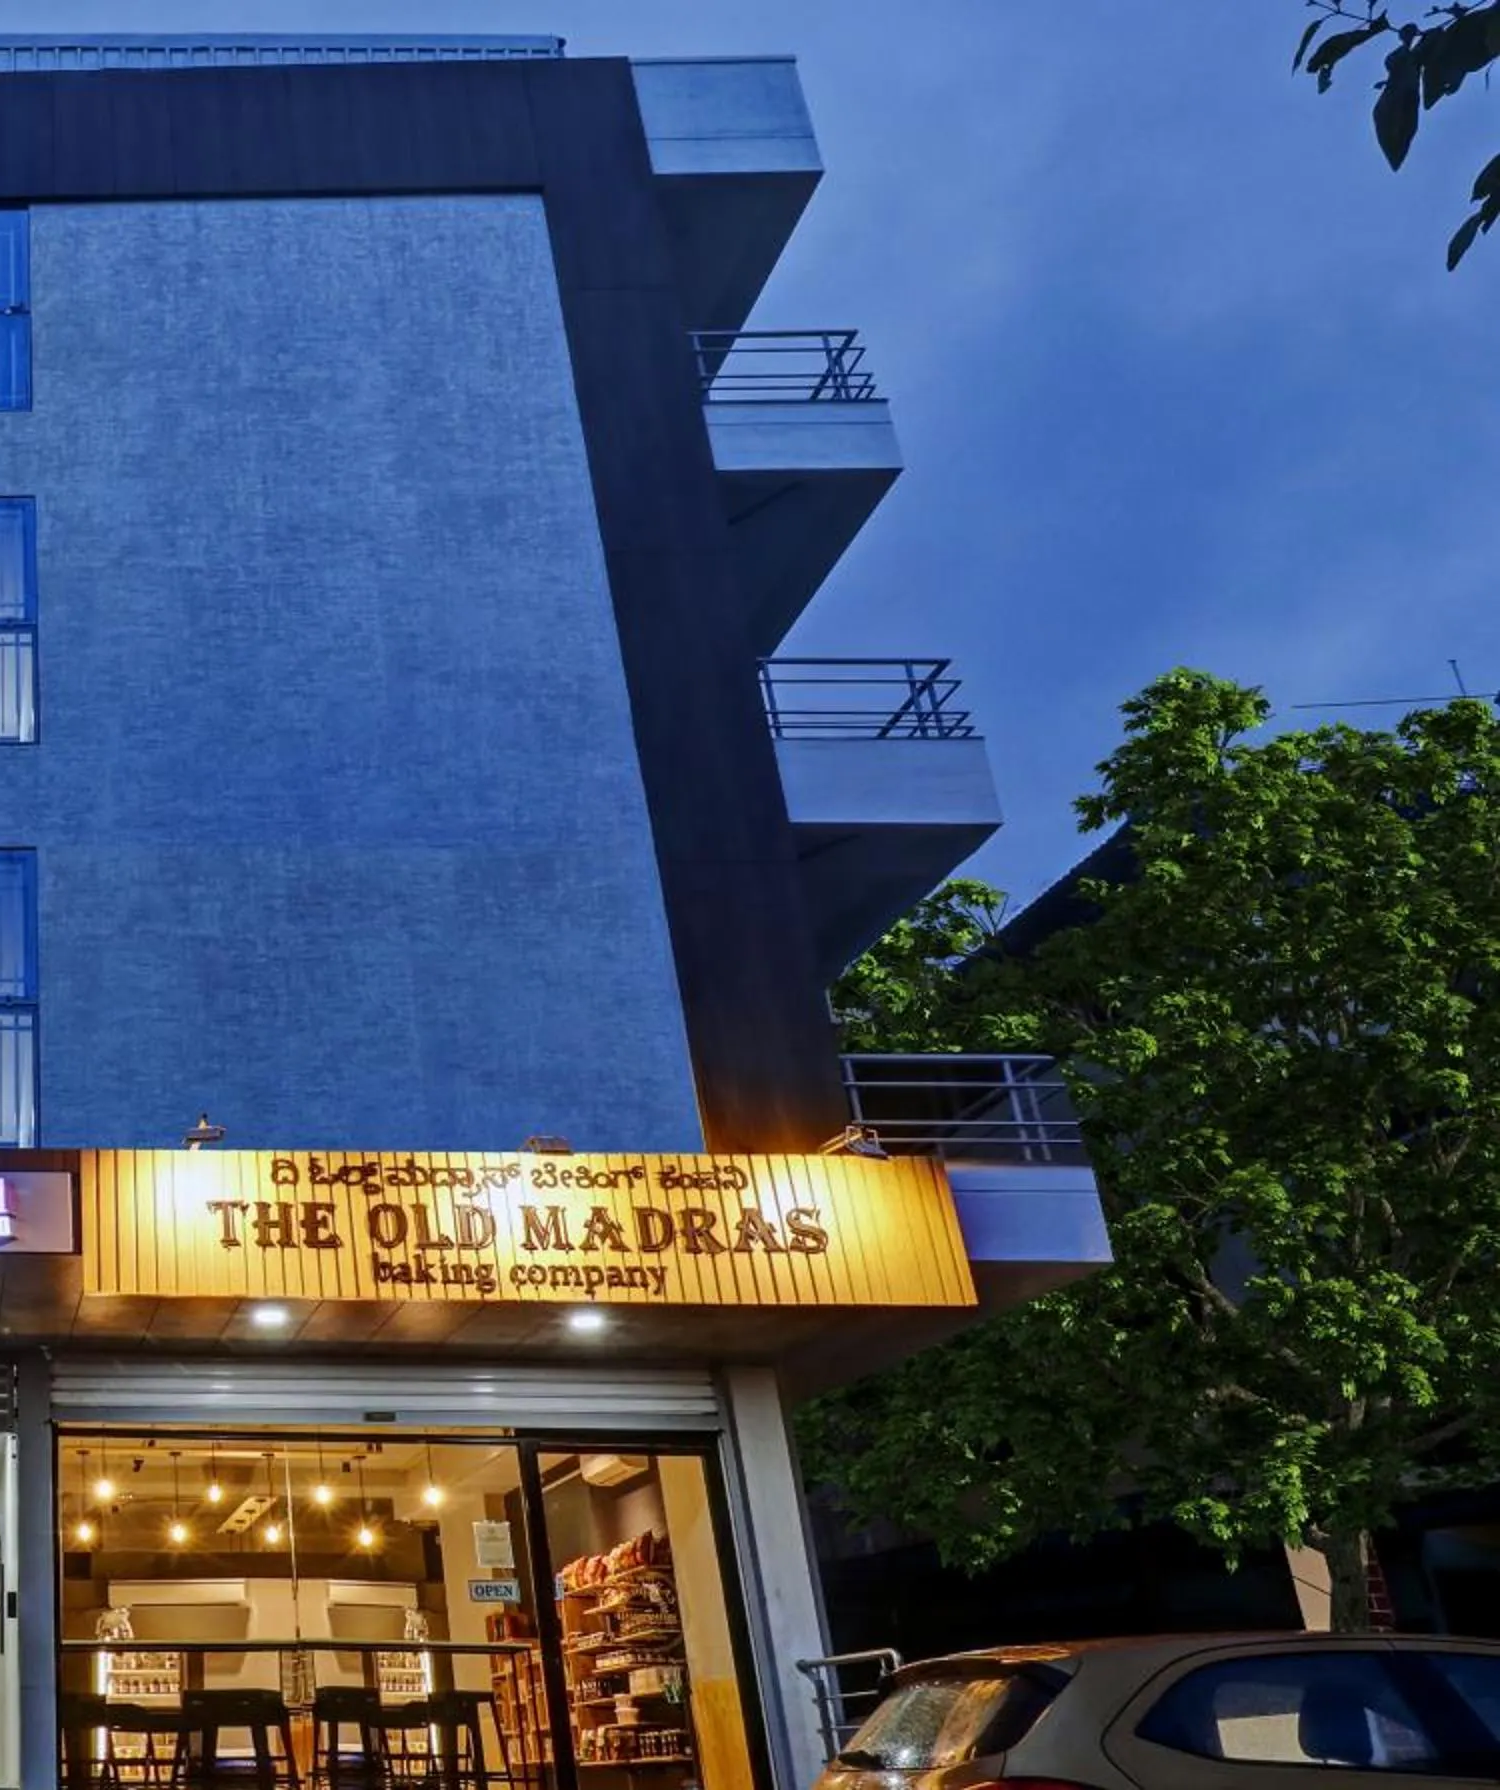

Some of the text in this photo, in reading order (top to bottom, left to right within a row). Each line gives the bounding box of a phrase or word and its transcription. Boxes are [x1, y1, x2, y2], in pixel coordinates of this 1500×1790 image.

[272, 1159, 299, 1185] ದಿ
[209, 1200, 829, 1255] THE OLD MADRAS
[372, 1251, 668, 1296] baking company
[474, 1585, 514, 1597] OPEN
